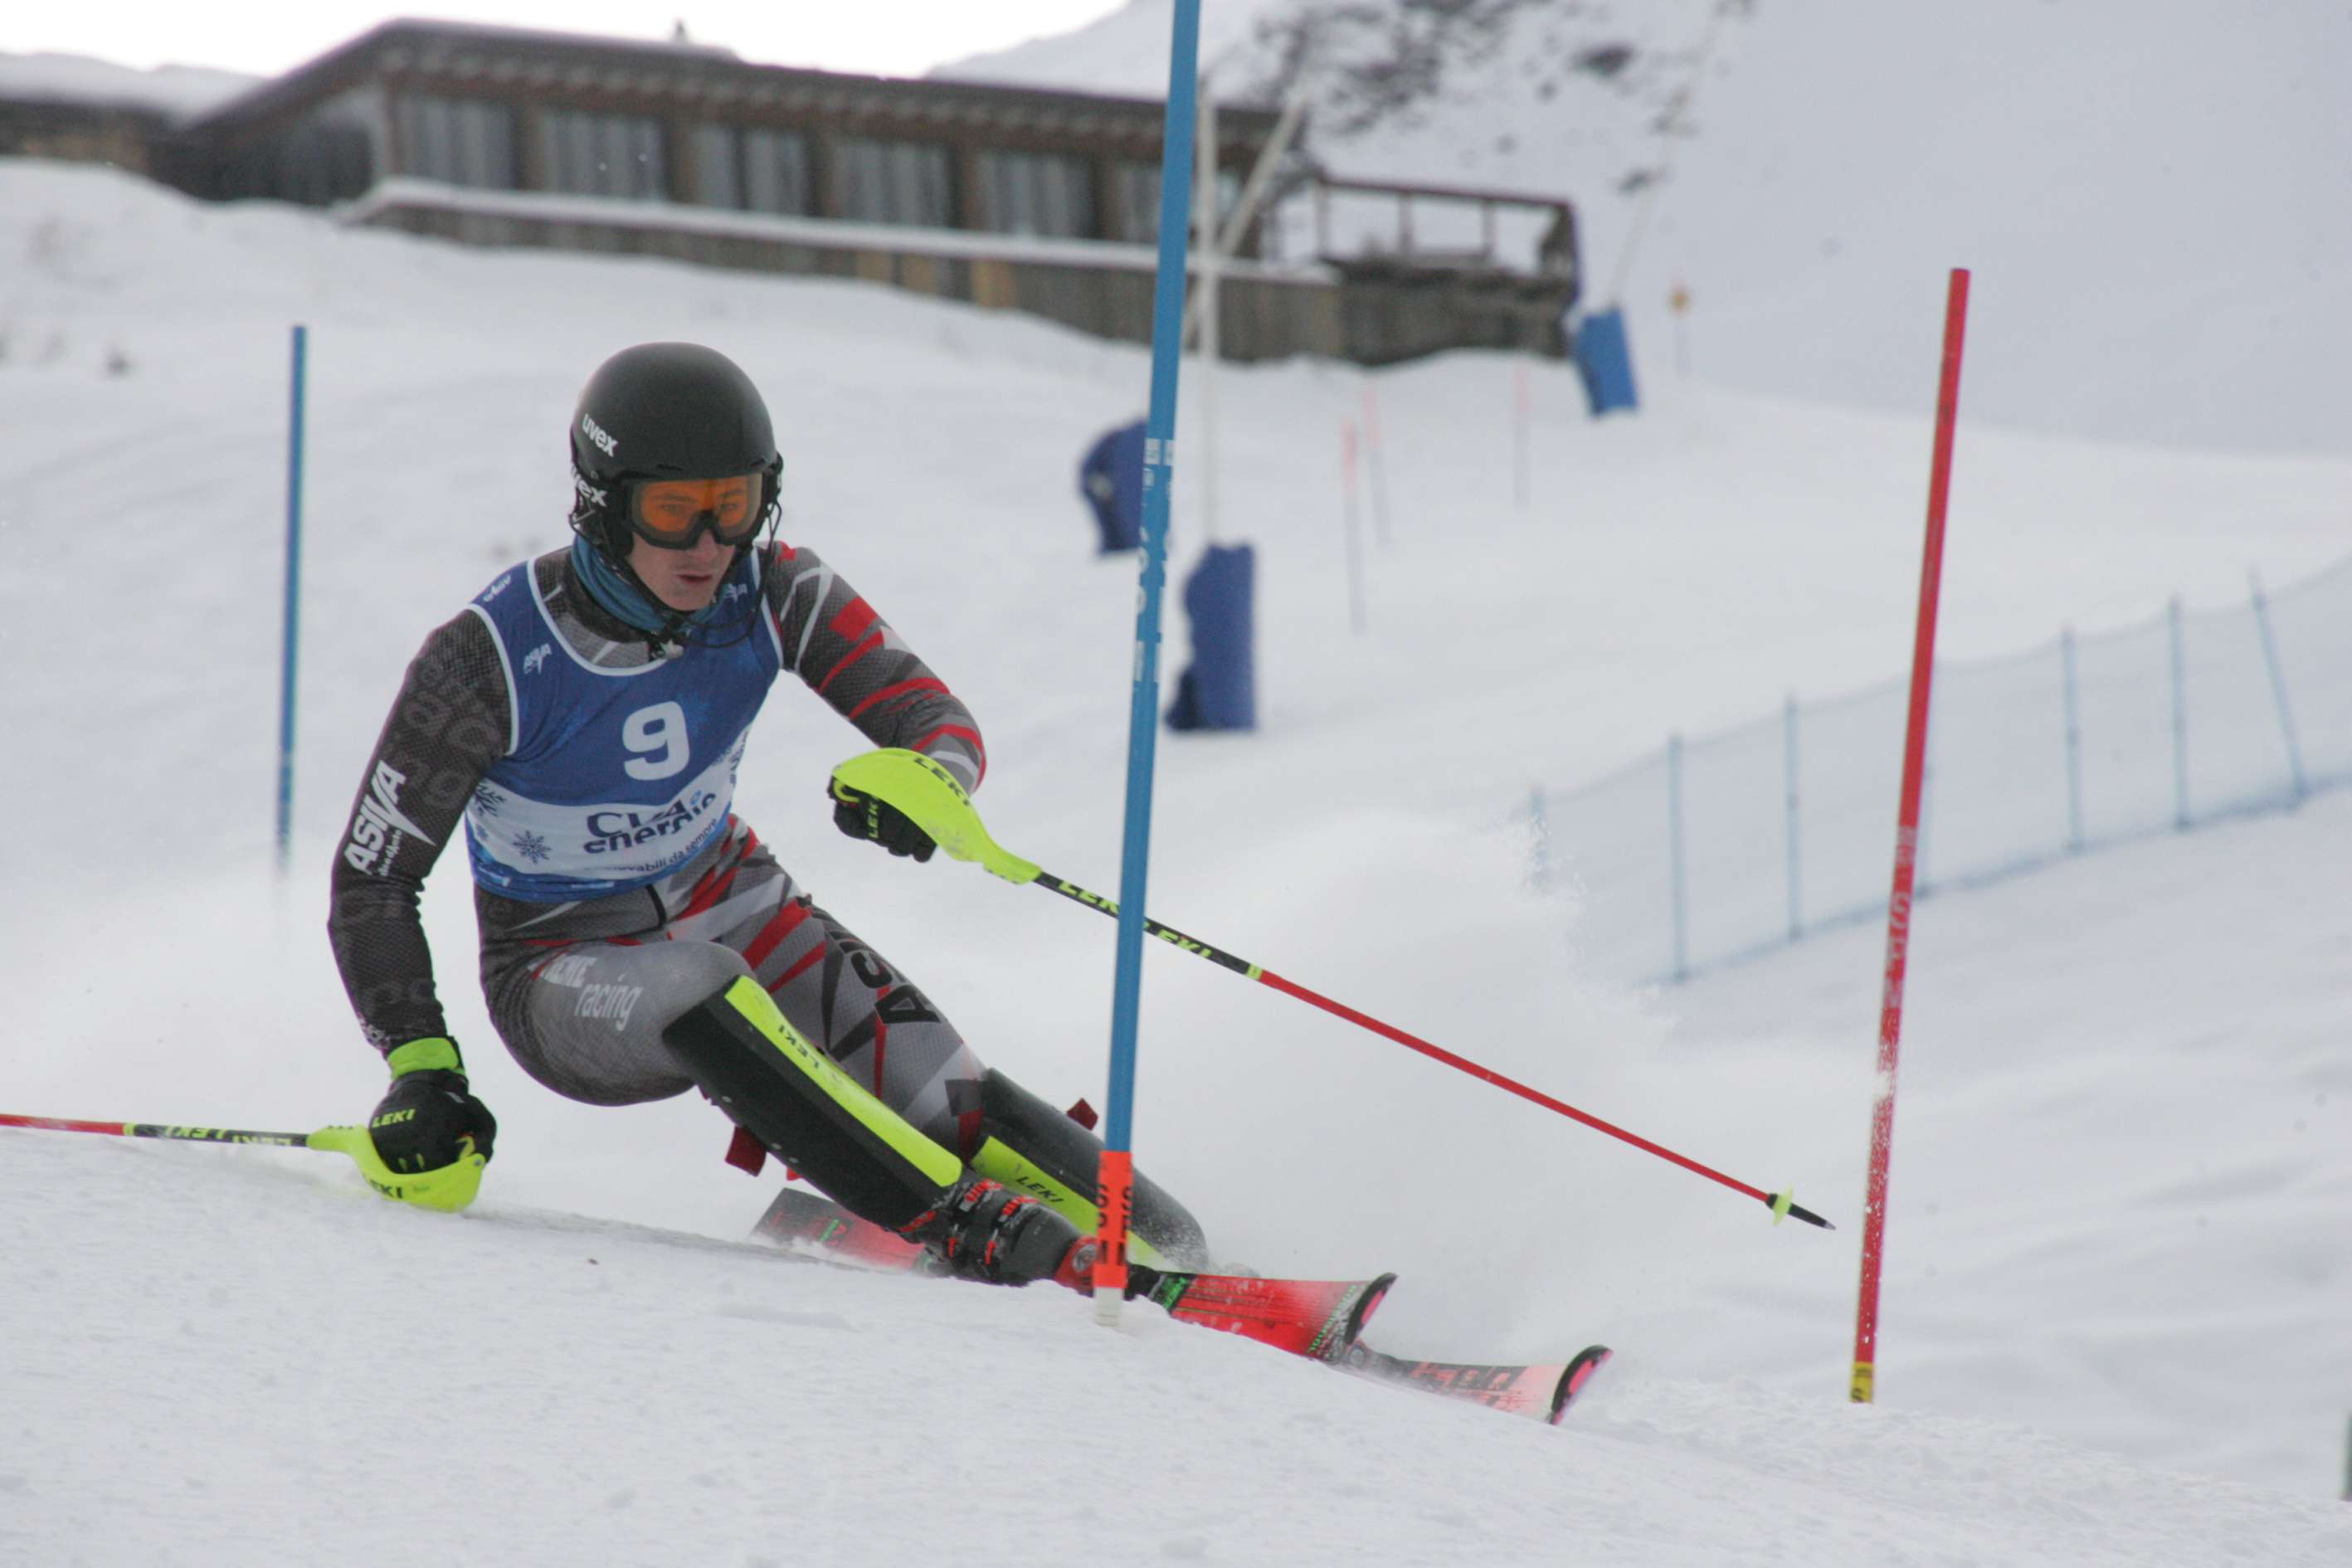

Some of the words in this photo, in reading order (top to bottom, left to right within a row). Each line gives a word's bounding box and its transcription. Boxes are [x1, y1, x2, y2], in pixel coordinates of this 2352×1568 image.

[582, 414, 618, 457] uvex
[622, 700, 690, 781] 9
[372, 1108, 416, 1128] LEKI
[1015, 1176, 1065, 1203] LEKI
